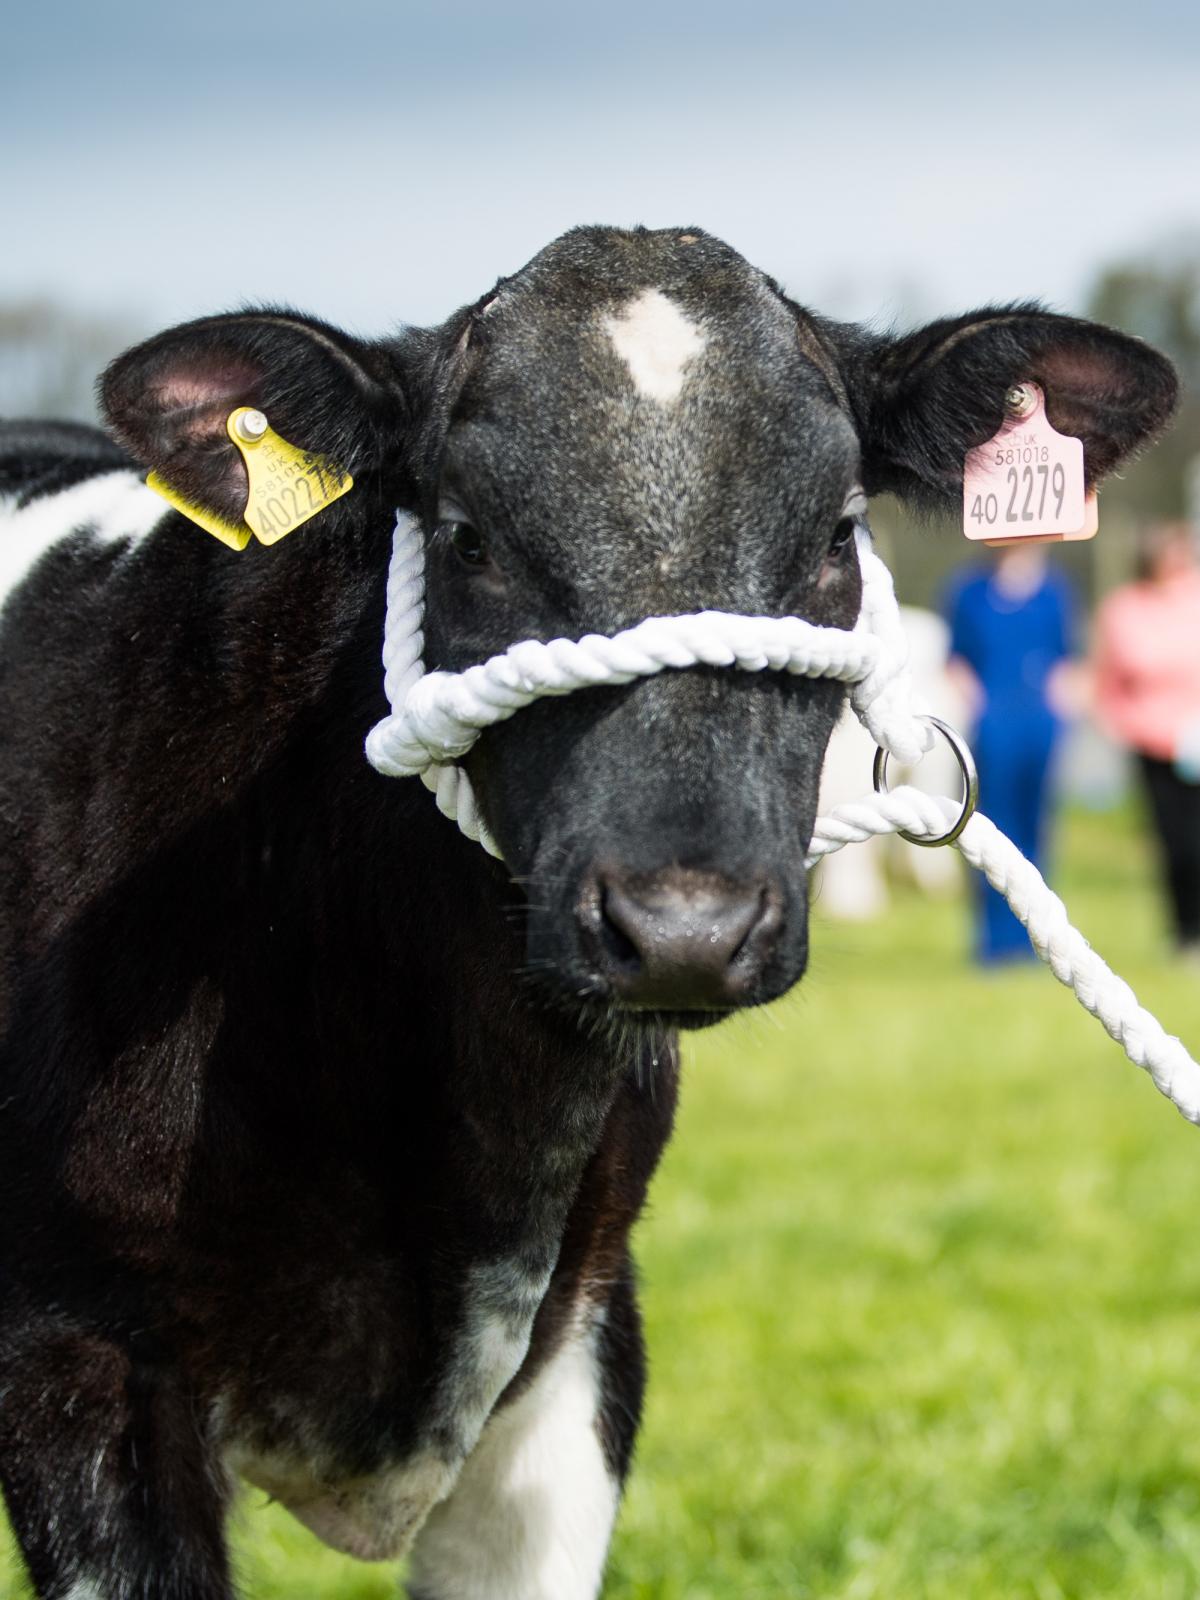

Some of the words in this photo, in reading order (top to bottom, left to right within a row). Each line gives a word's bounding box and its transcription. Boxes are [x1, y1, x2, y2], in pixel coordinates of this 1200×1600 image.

[1024, 435, 1037, 445] UK
[267, 456, 289, 473] UK
[995, 446, 1049, 466] 581018
[970, 493, 998, 525] 40
[1005, 462, 1066, 523] 2279
